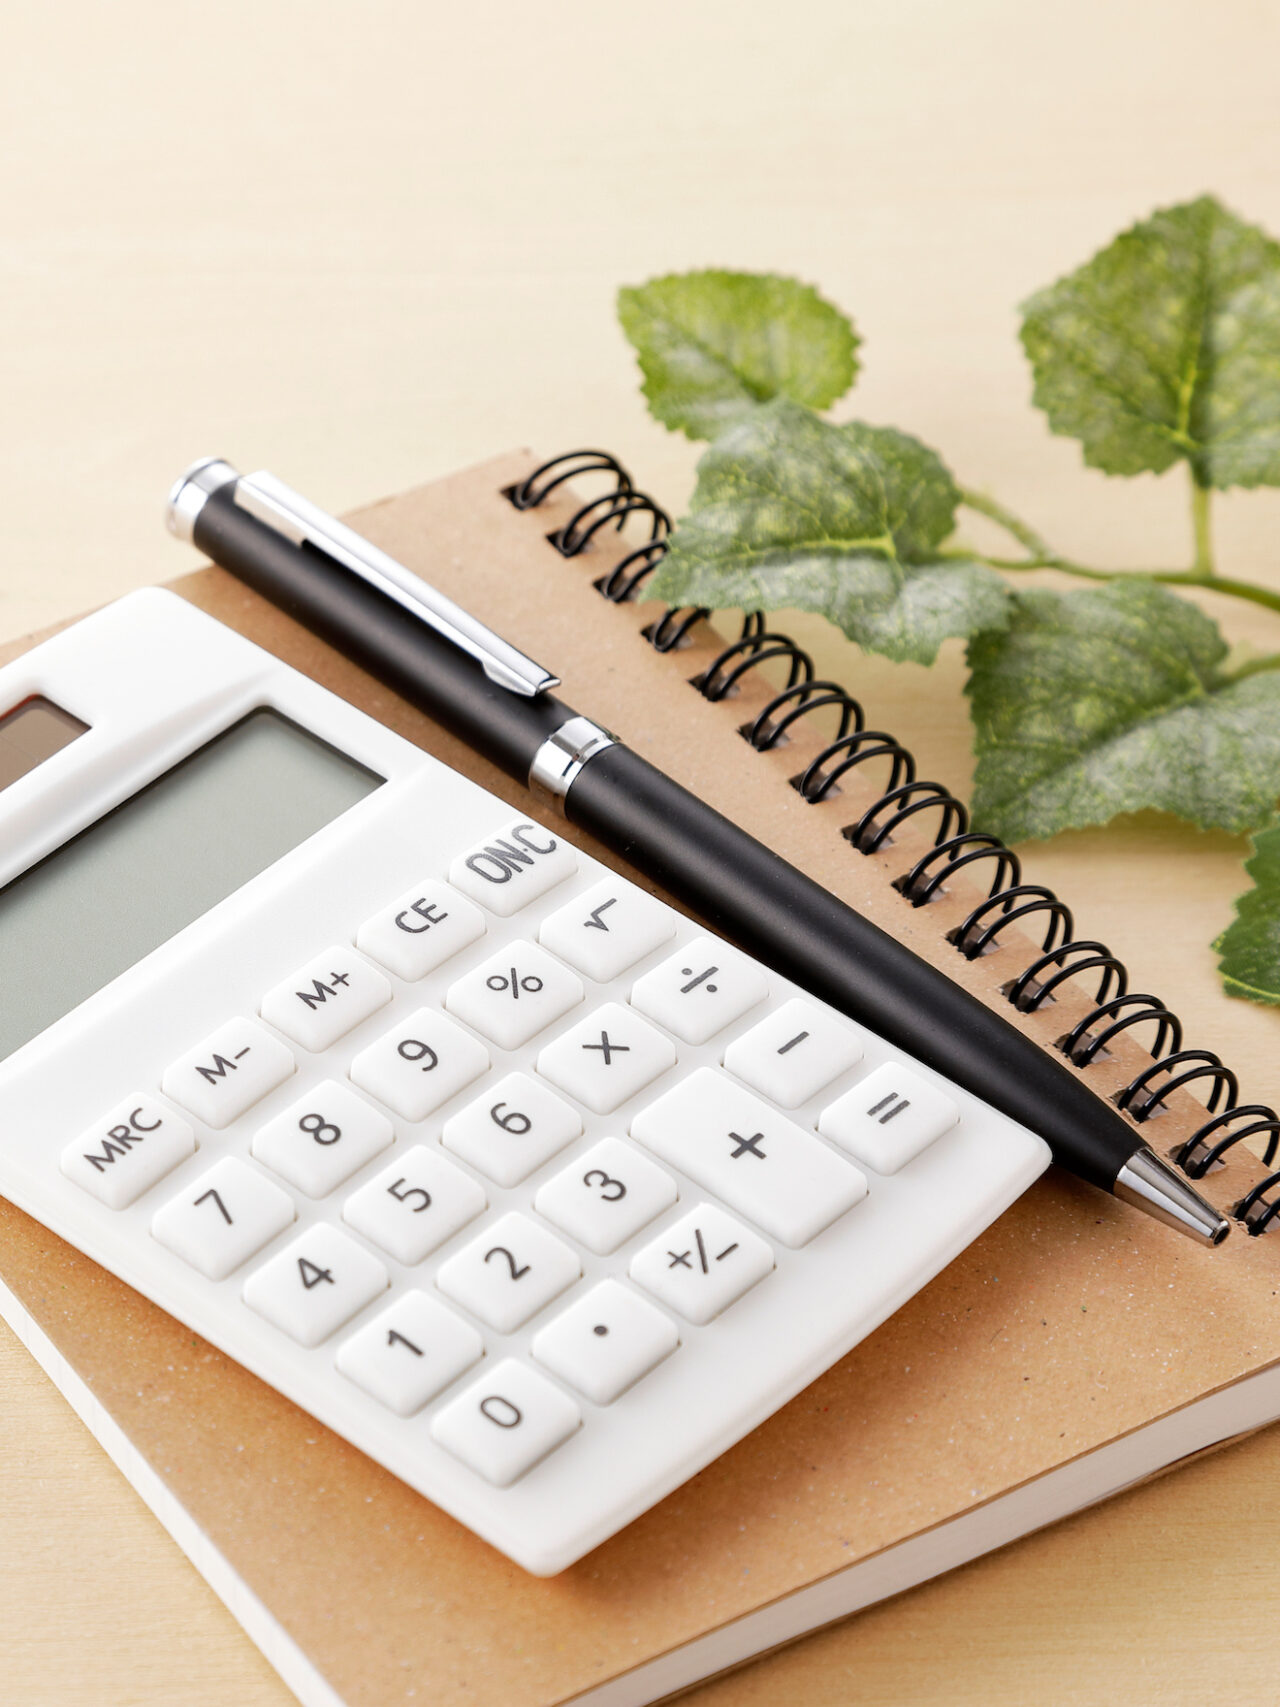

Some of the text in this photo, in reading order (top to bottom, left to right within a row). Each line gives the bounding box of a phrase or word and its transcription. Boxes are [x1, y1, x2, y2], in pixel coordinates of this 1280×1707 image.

[394, 897, 449, 934] CE
[295, 971, 351, 1011] M+
[485, 966, 545, 1001] %
[396, 1038, 440, 1073] 9
[489, 1101, 533, 1136] 6
[865, 1091, 912, 1126] =
[82, 1106, 164, 1174] MRC
[297, 1112, 343, 1147] 8
[727, 1130, 768, 1161] +
[386, 1177, 433, 1214] 5
[582, 1168, 628, 1203] 3
[192, 1187, 234, 1226] 7
[296, 1256, 336, 1291] 4
[483, 1245, 532, 1282] 2
[386, 1327, 425, 1358] 1
[479, 1394, 523, 1430] 0
